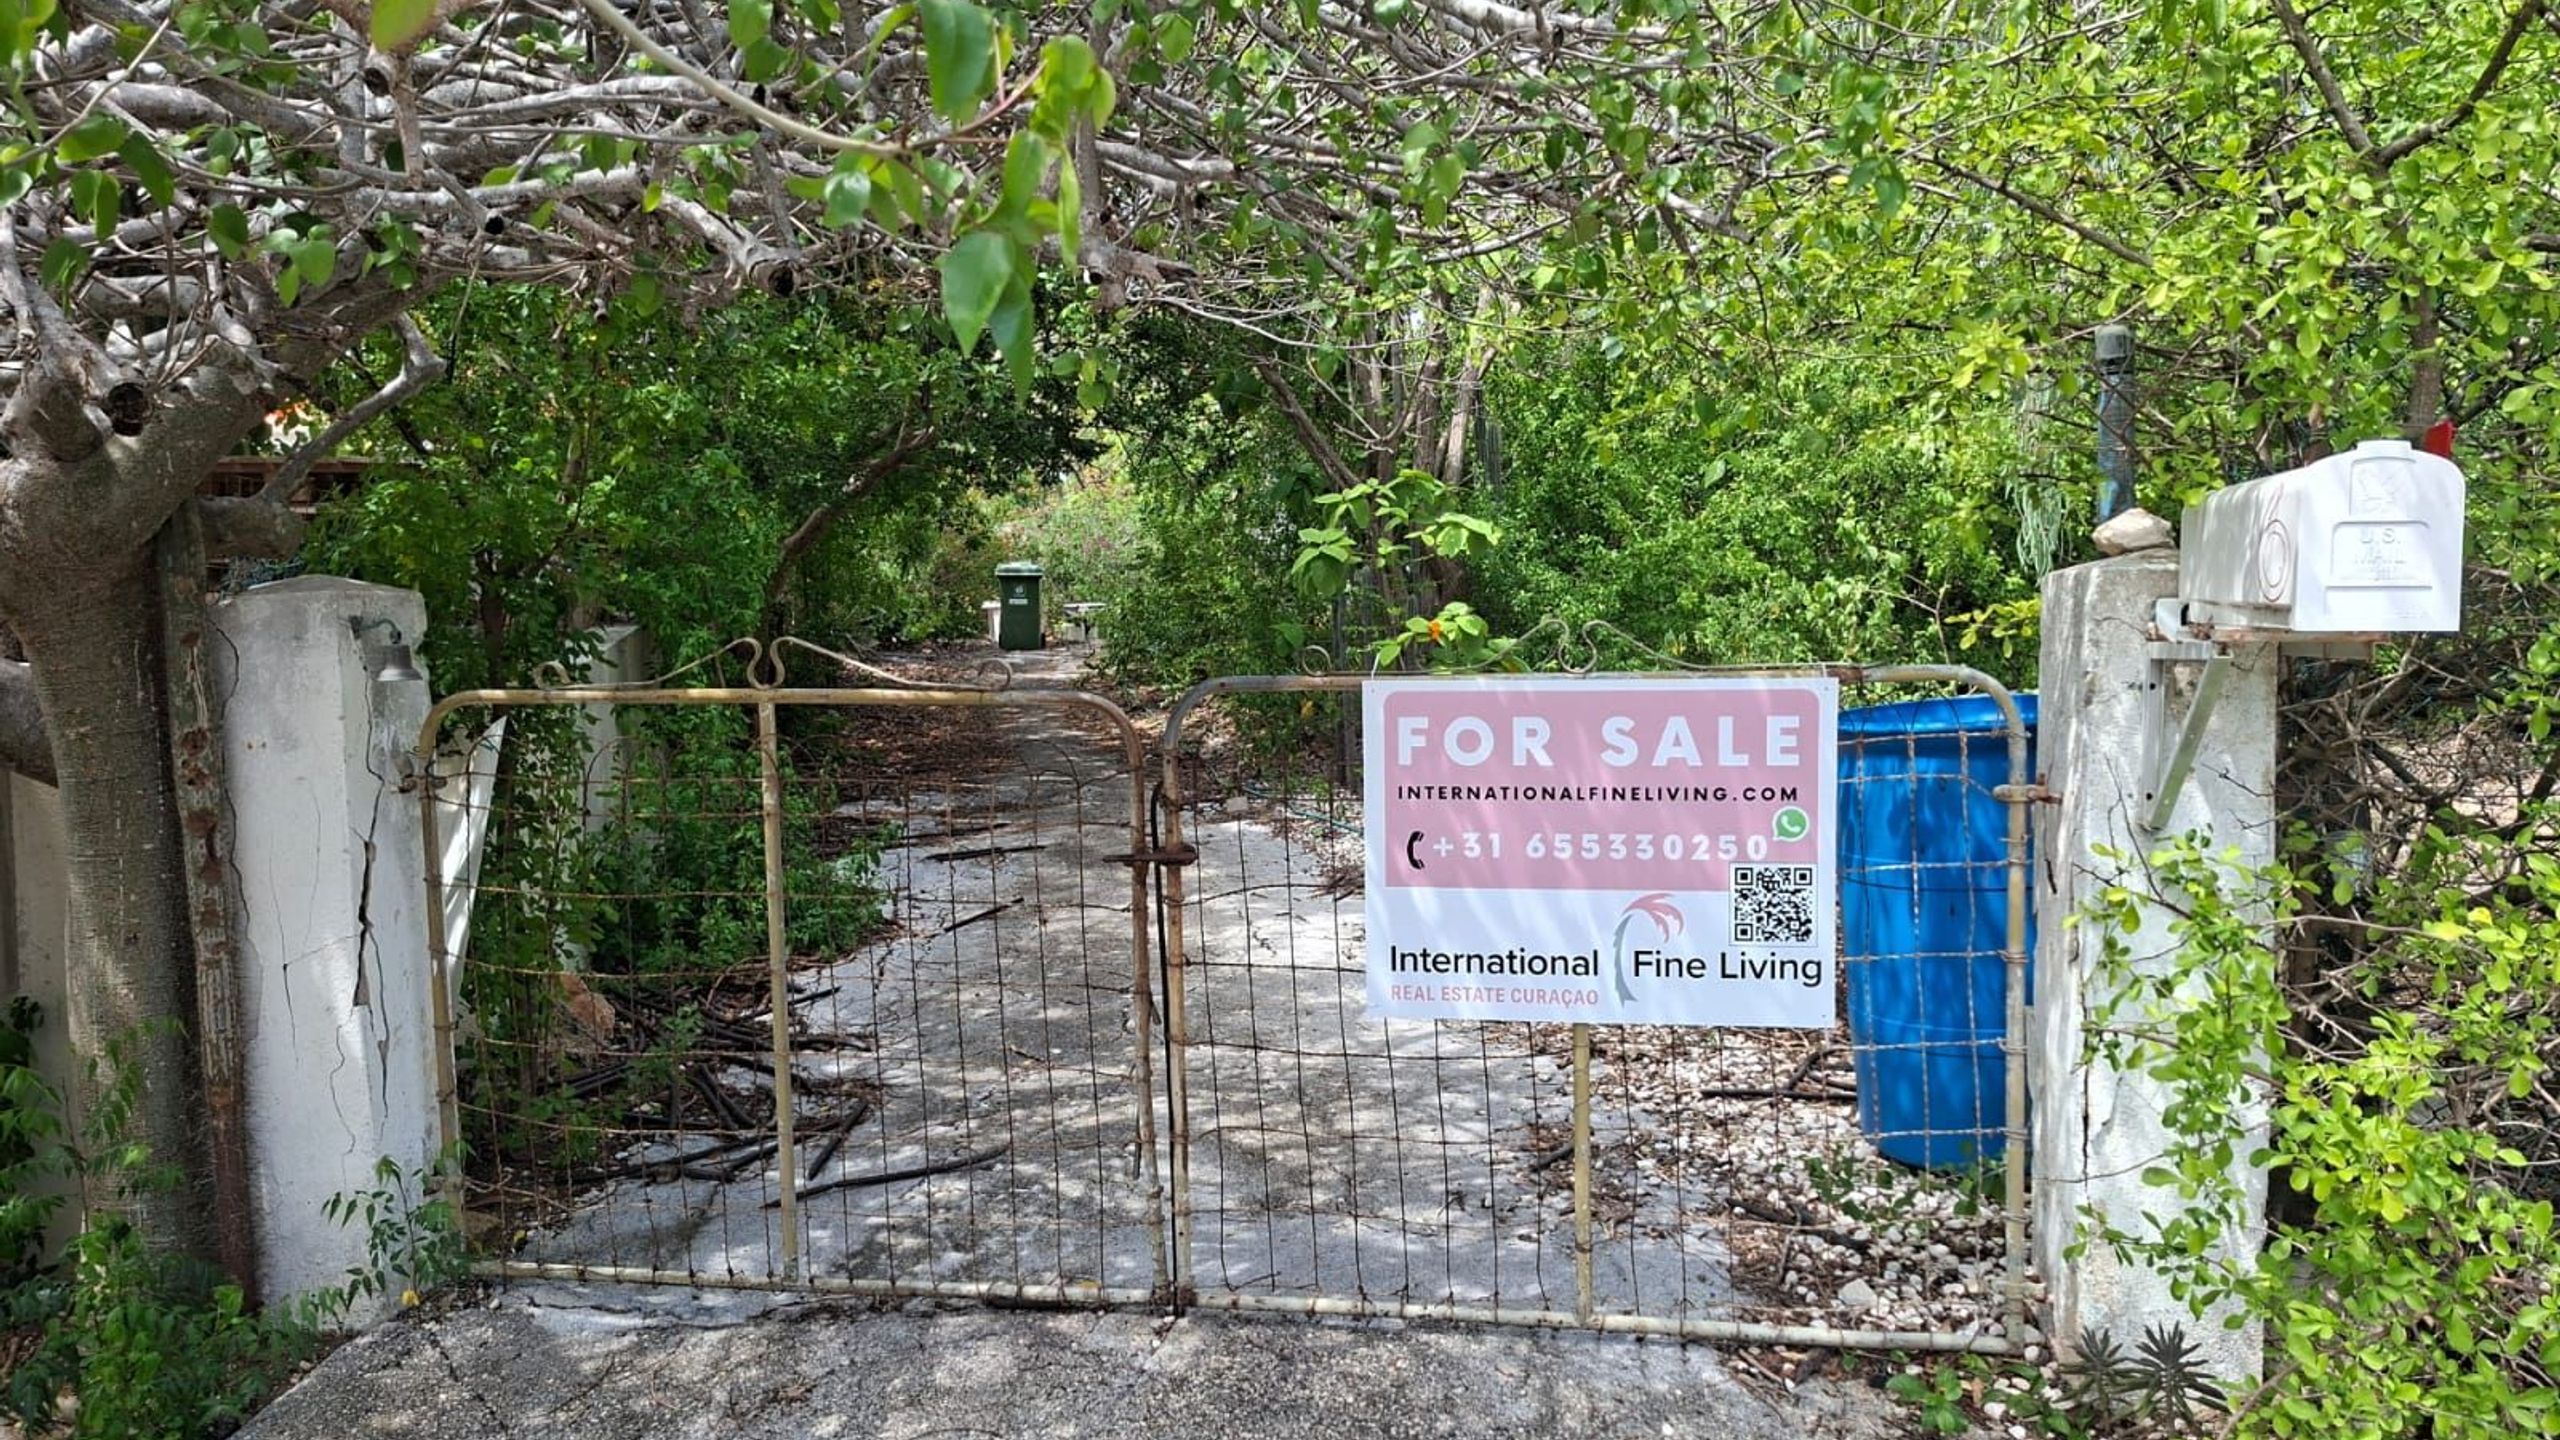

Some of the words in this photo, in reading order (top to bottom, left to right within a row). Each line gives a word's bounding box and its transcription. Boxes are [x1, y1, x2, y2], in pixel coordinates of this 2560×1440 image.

[2358, 526, 2402, 545] U.S.
[1397, 715, 1554, 767] FOR
[1600, 715, 1801, 768] SALE
[1397, 785, 1799, 802] INTERNATIONALFINELIVING.COM
[1432, 832, 1502, 859] +31
[1525, 833, 1769, 861] 655330250
[1390, 945, 1600, 977] International
[1632, 949, 1708, 979] Fine
[1719, 951, 1824, 988] Living
[1391, 984, 1436, 1001] REAL
[1441, 986, 1506, 1004] ESTATE
[1510, 987, 1600, 1009] CURAÇAO
